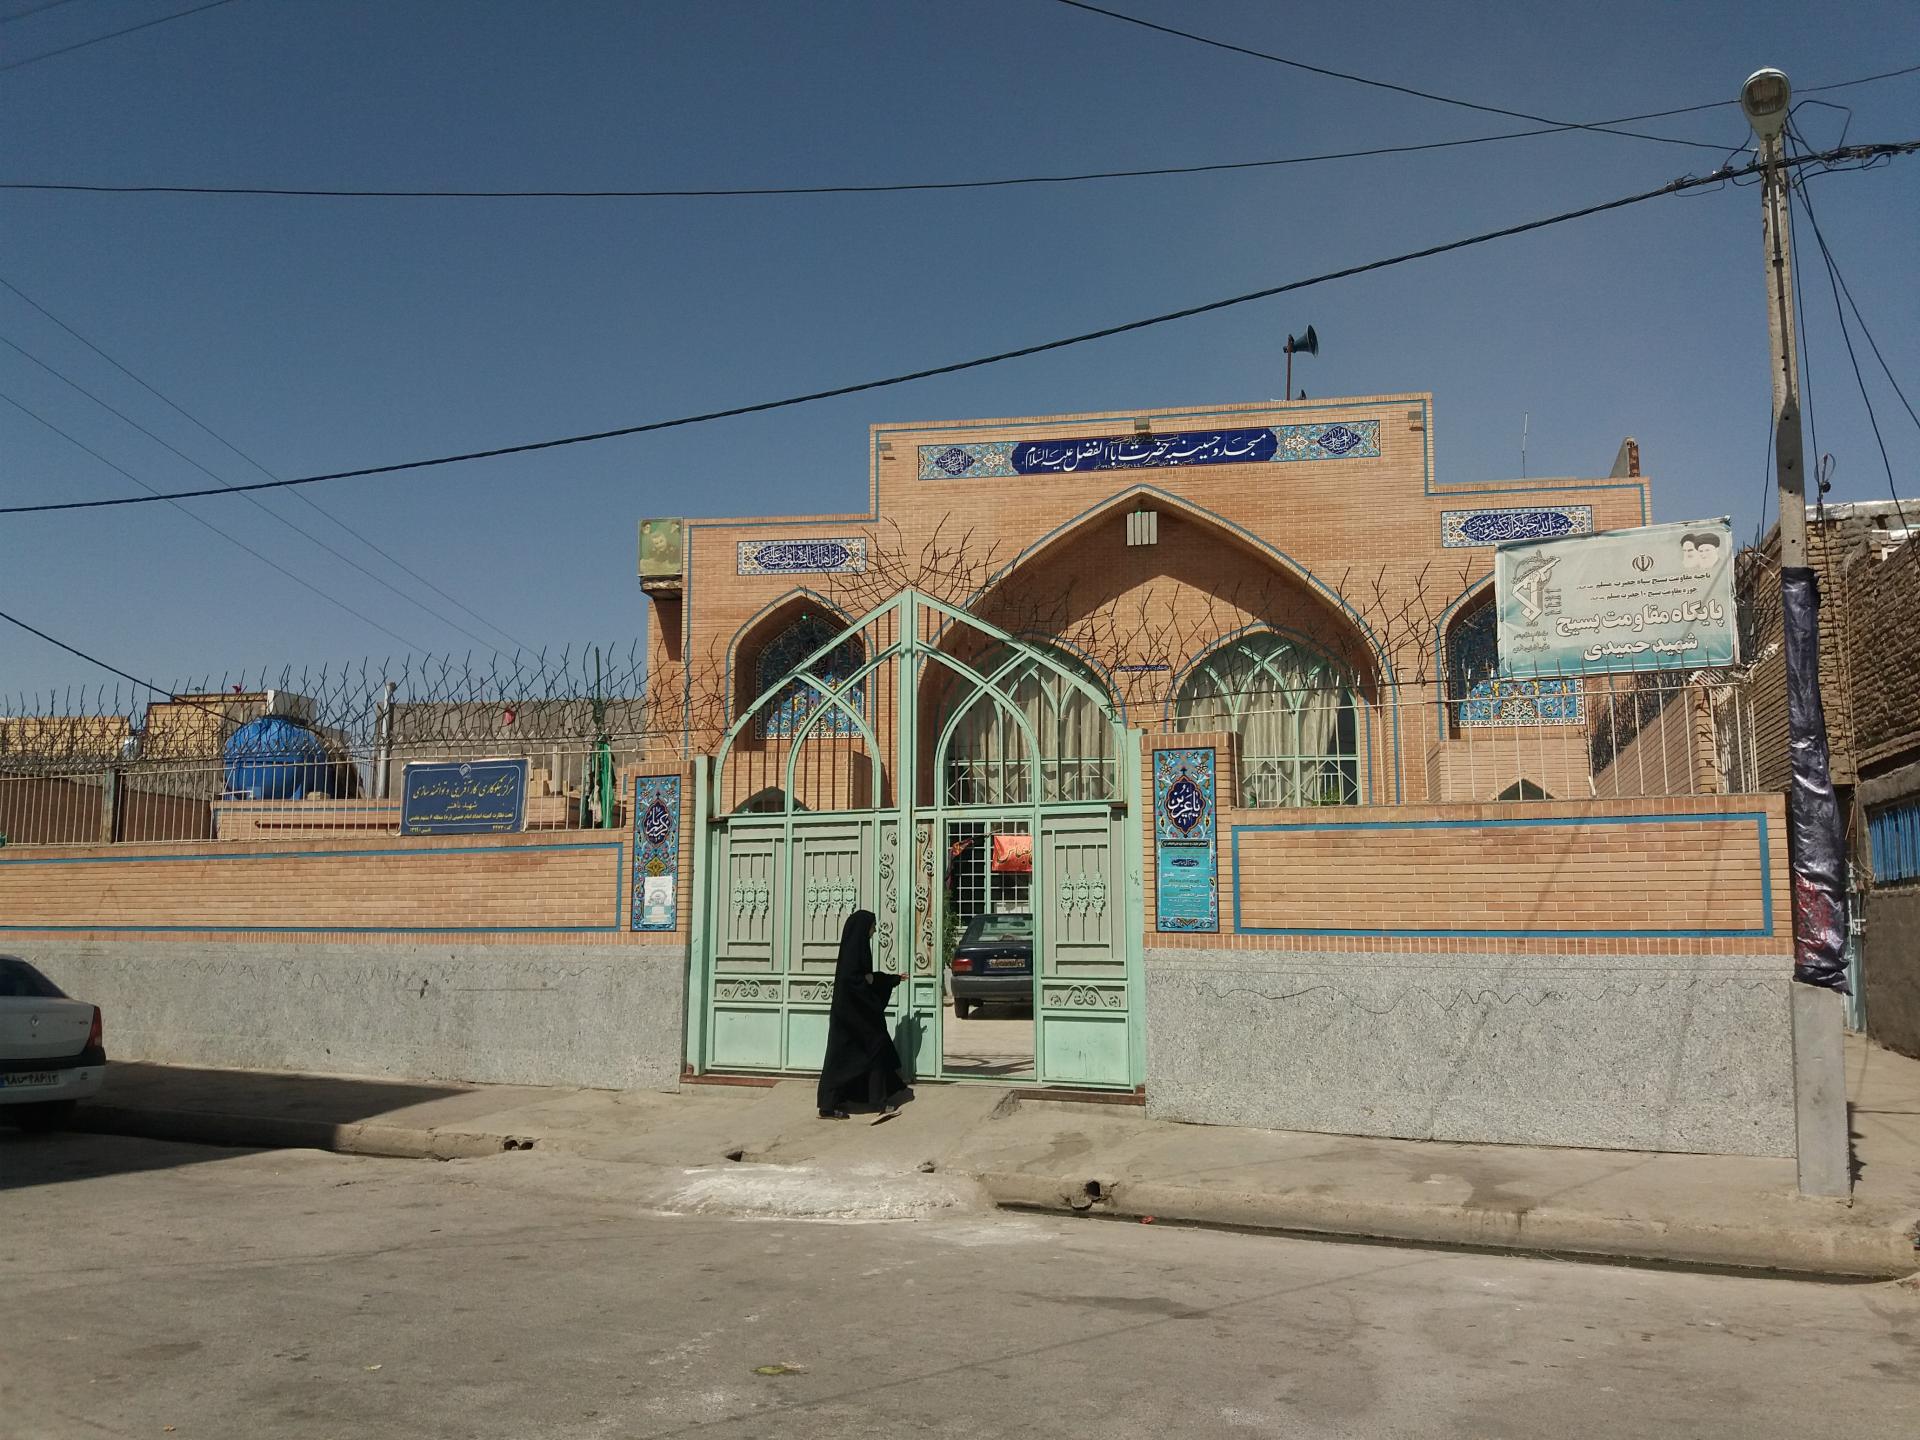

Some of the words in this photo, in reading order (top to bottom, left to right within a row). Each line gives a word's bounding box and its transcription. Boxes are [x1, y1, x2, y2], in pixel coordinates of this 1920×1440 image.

[1164, 434, 1222, 464] حسینیه
[1210, 446, 1219, 458] و
[1218, 433, 1267, 456] مسجد
[1555, 612, 1601, 637] بسیج
[1601, 603, 1670, 632] مقاومت
[1671, 599, 1725, 627] پایگاه
[1583, 638, 1651, 661] حمیدی
[1652, 632, 1699, 656] شهید
[462, 801, 478, 811] شهید
